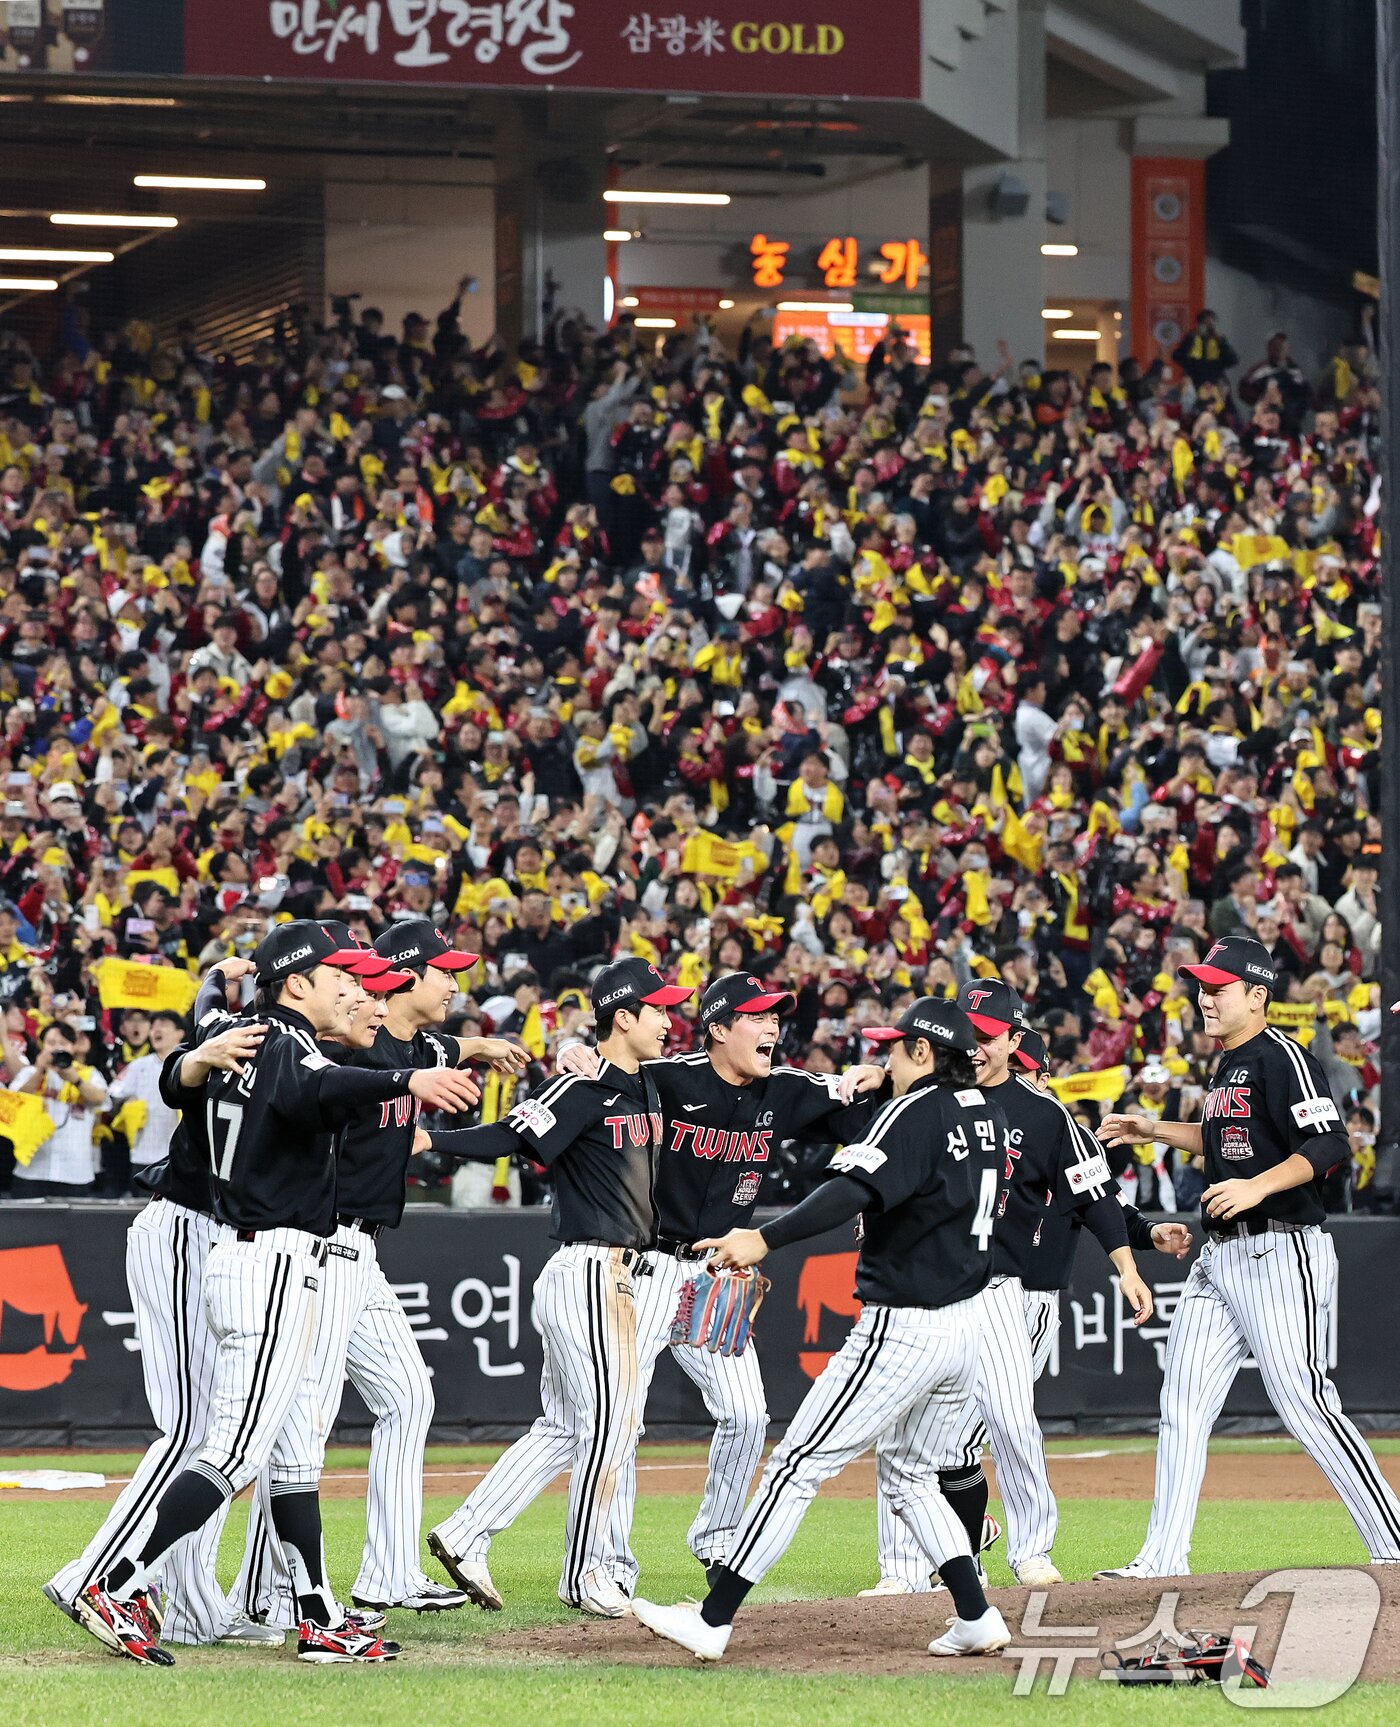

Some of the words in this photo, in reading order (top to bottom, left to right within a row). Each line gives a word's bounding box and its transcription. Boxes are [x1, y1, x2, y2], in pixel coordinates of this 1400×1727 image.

[730, 21, 844, 56] GOLD
[272, 944, 313, 971] LGE.COM
[389, 946, 421, 964] E.COM
[598, 984, 633, 1008] LGE.COM
[968, 989, 993, 1010] T
[701, 996, 728, 1021] LGE.COM
[913, 1017, 955, 1041] LGE.COM
[1229, 1069, 1249, 1085] LG
[755, 1110, 774, 1128] LG
[206, 1097, 245, 1182] 17
[670, 1119, 774, 1163] TWINS
[946, 1119, 1010, 1162] 신민
[1221, 1147, 1253, 1157] SERIES
[969, 1167, 998, 1252] 4
